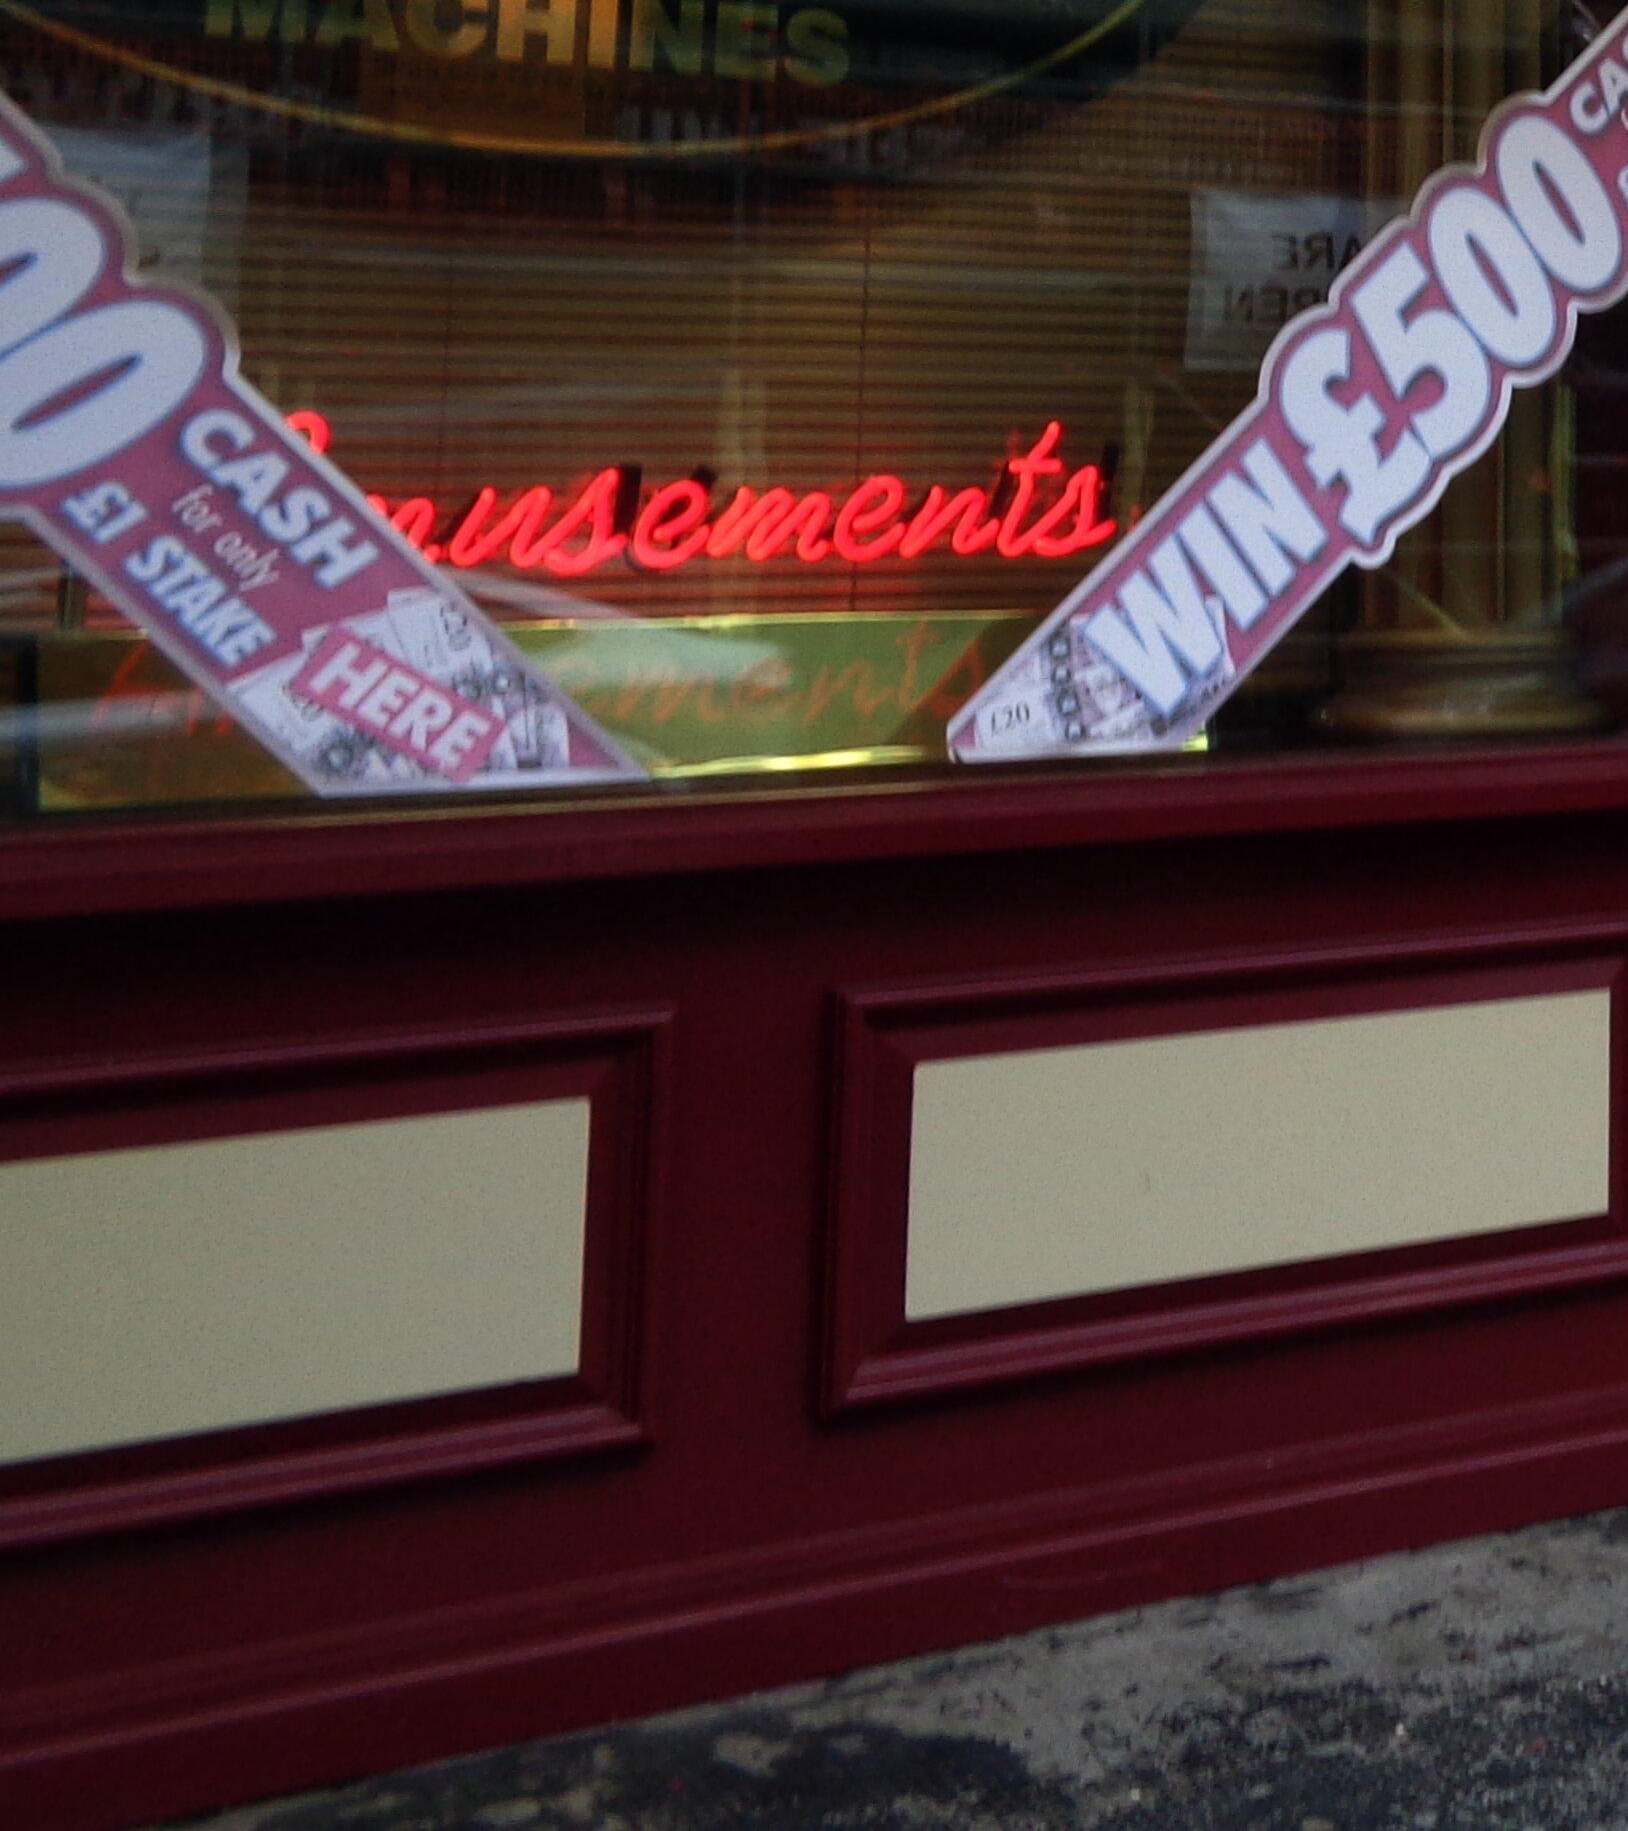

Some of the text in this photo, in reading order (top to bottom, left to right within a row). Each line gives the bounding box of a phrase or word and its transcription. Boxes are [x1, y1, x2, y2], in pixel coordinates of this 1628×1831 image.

[179, 408, 380, 589] CASH
[286, 410, 1121, 575] usements
[1081, 113, 1623, 717] WIN £500
[62, 480, 277, 668] £1 STAKE
[172, 483, 282, 591] for only
[309, 641, 492, 773] HERE
